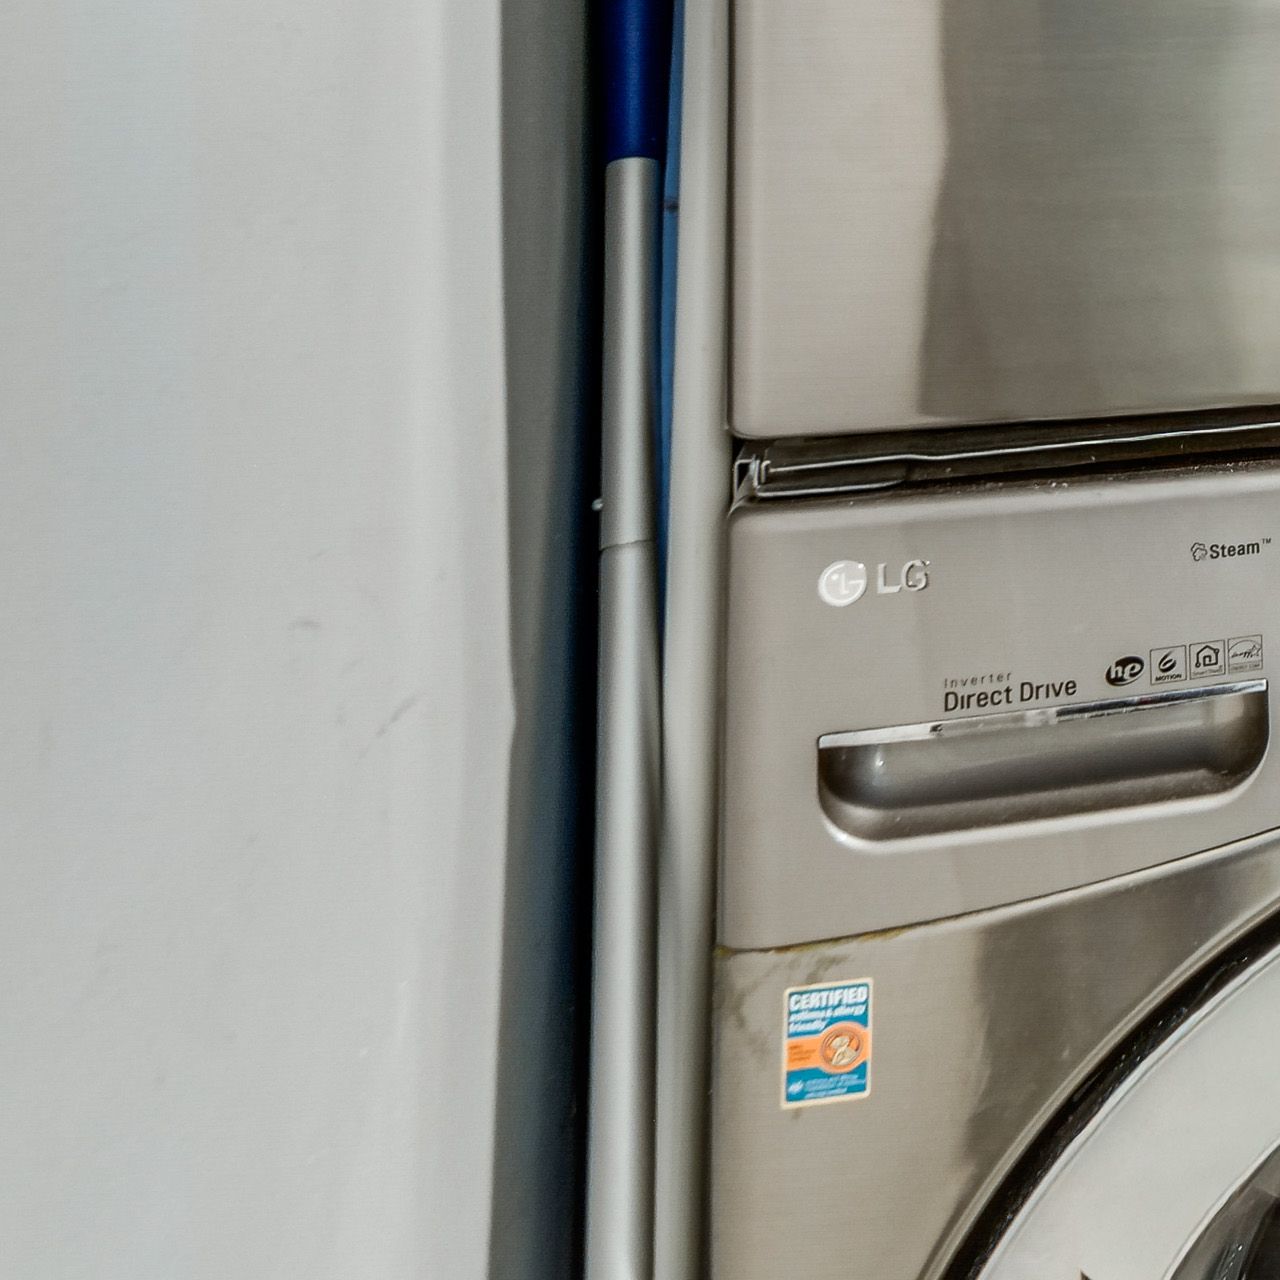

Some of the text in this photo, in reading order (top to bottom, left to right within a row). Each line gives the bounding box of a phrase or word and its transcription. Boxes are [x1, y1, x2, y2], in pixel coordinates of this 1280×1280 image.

[876, 559, 929, 594] LG
[944, 672, 1012, 688] Inverter
[1155, 674, 1182, 682] MOTION
[943, 679, 1077, 713] Direct Drive
[789, 985, 868, 1012] CERTIFIED
